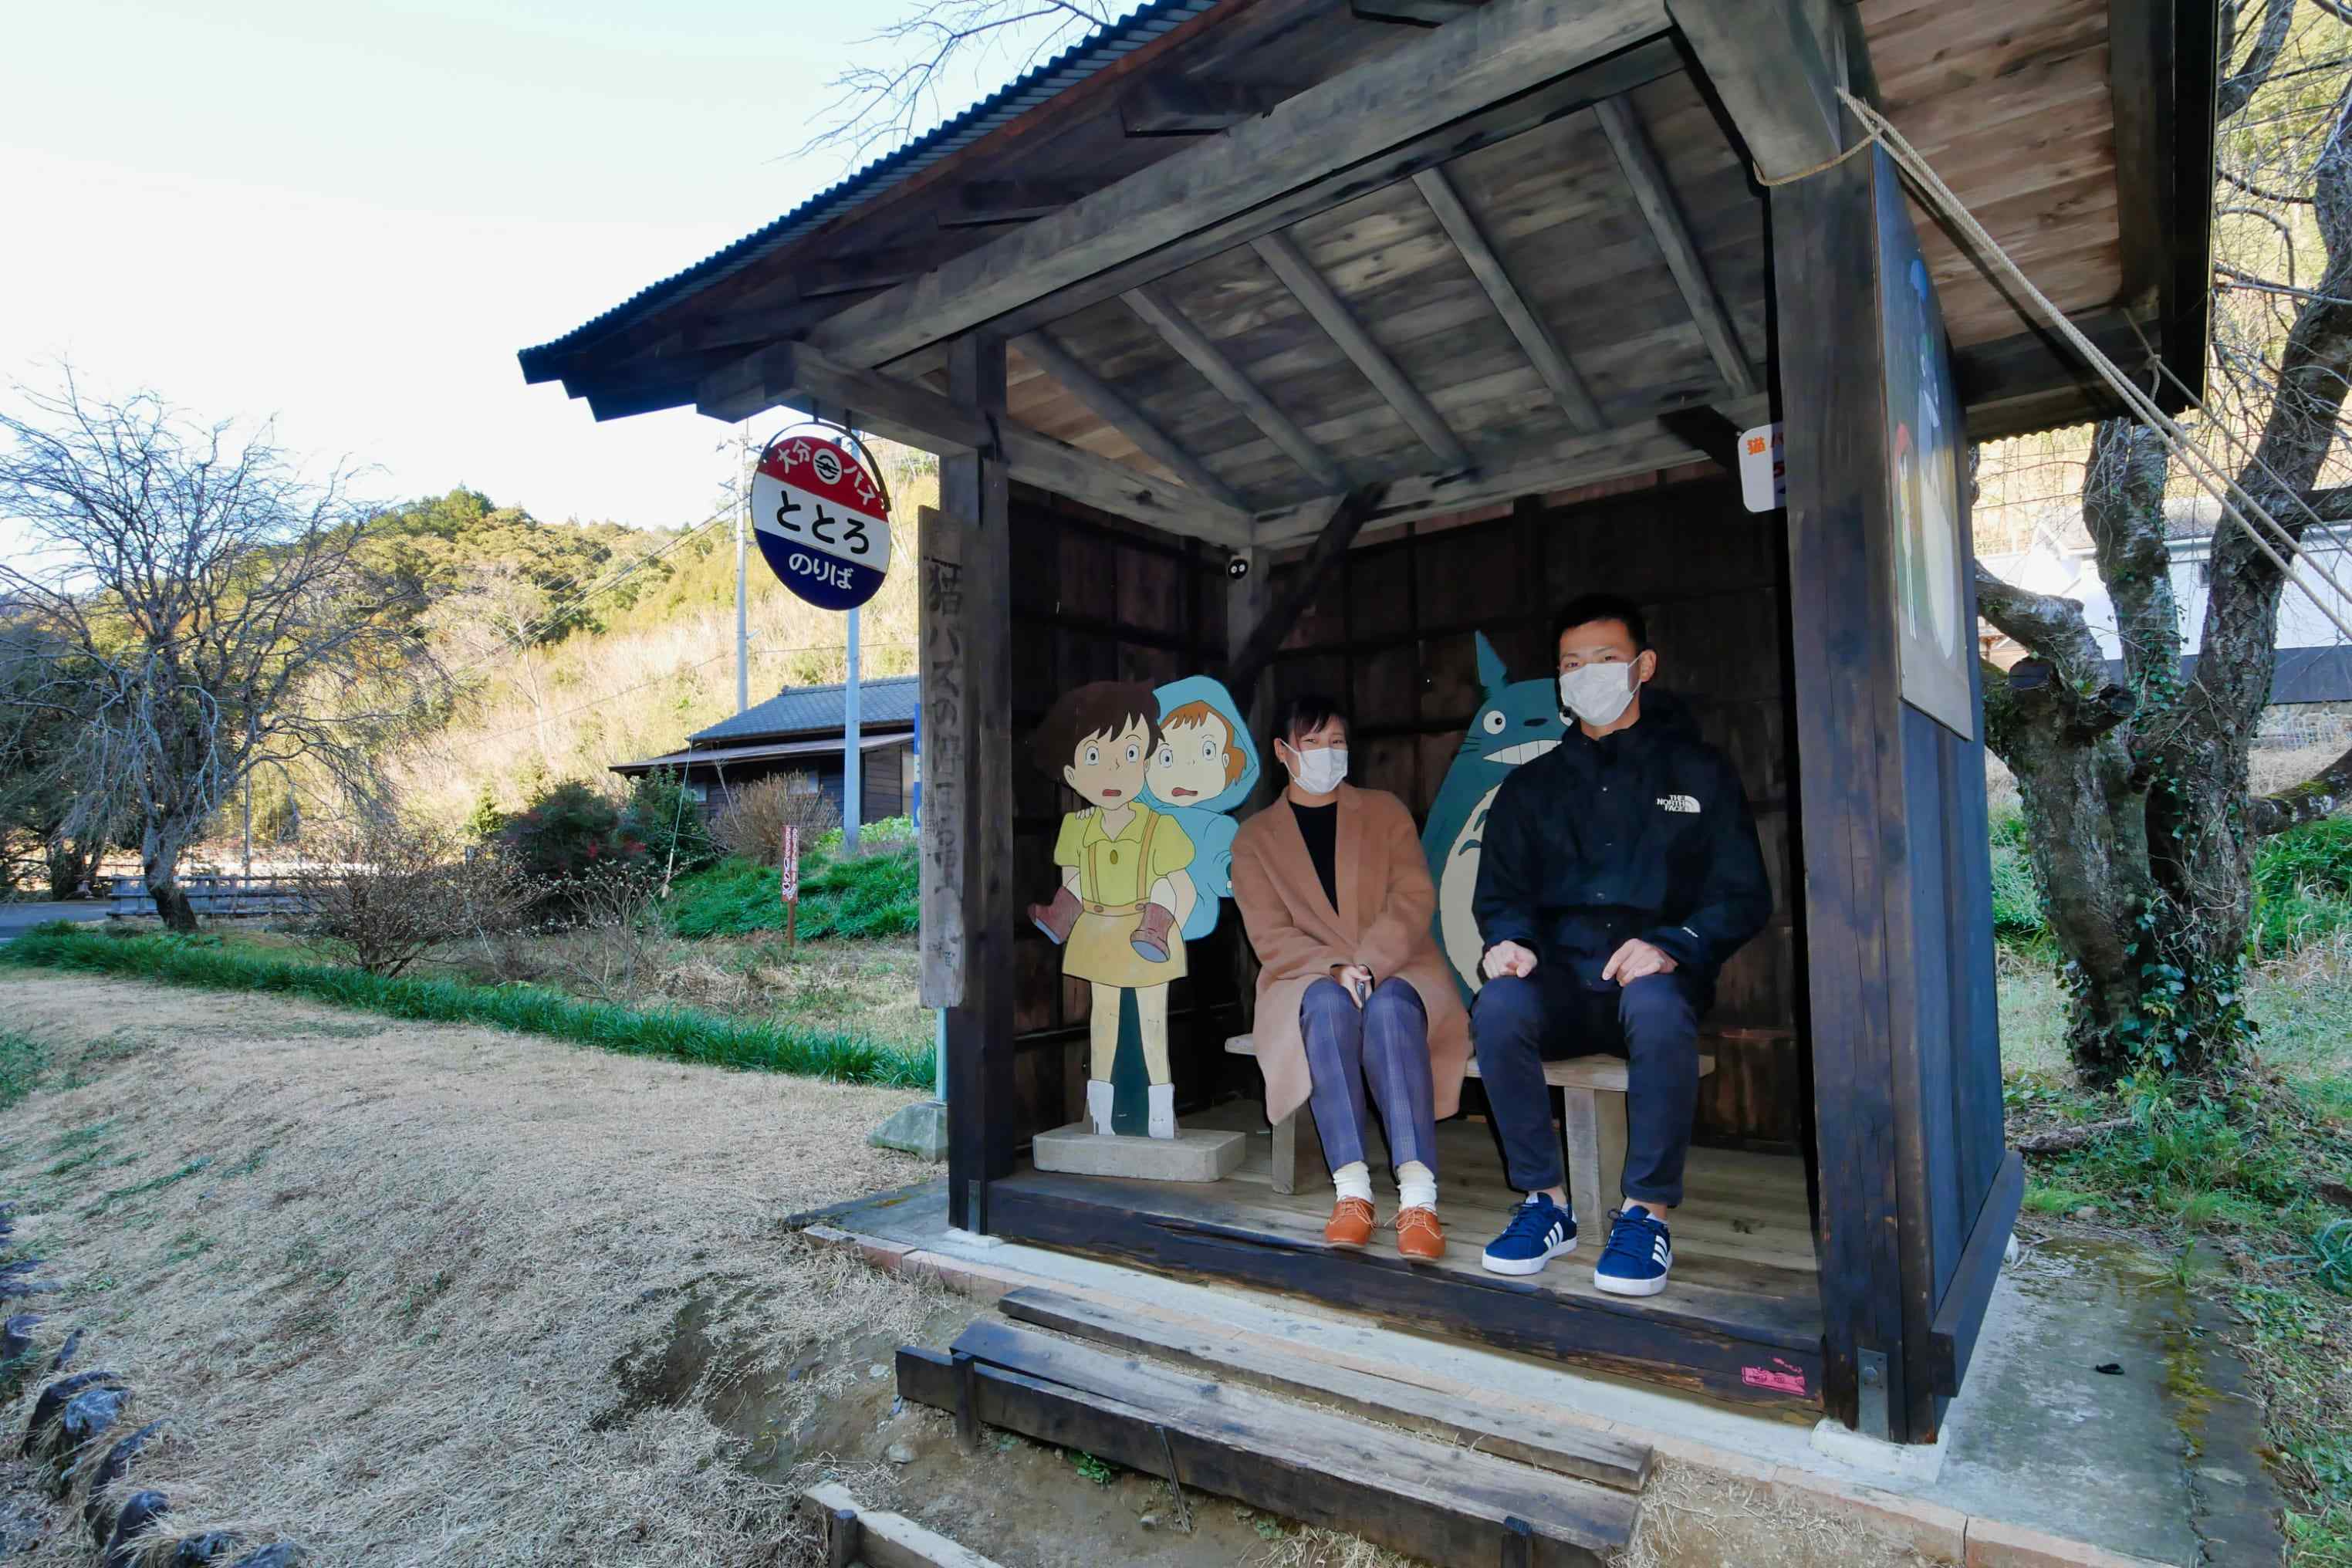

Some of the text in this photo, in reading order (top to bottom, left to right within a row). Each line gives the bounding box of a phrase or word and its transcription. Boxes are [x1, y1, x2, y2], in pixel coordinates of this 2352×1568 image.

[777, 439, 877, 506] 大分 バス
[776, 490, 870, 555] ととろ
[789, 553, 854, 590] のりば
